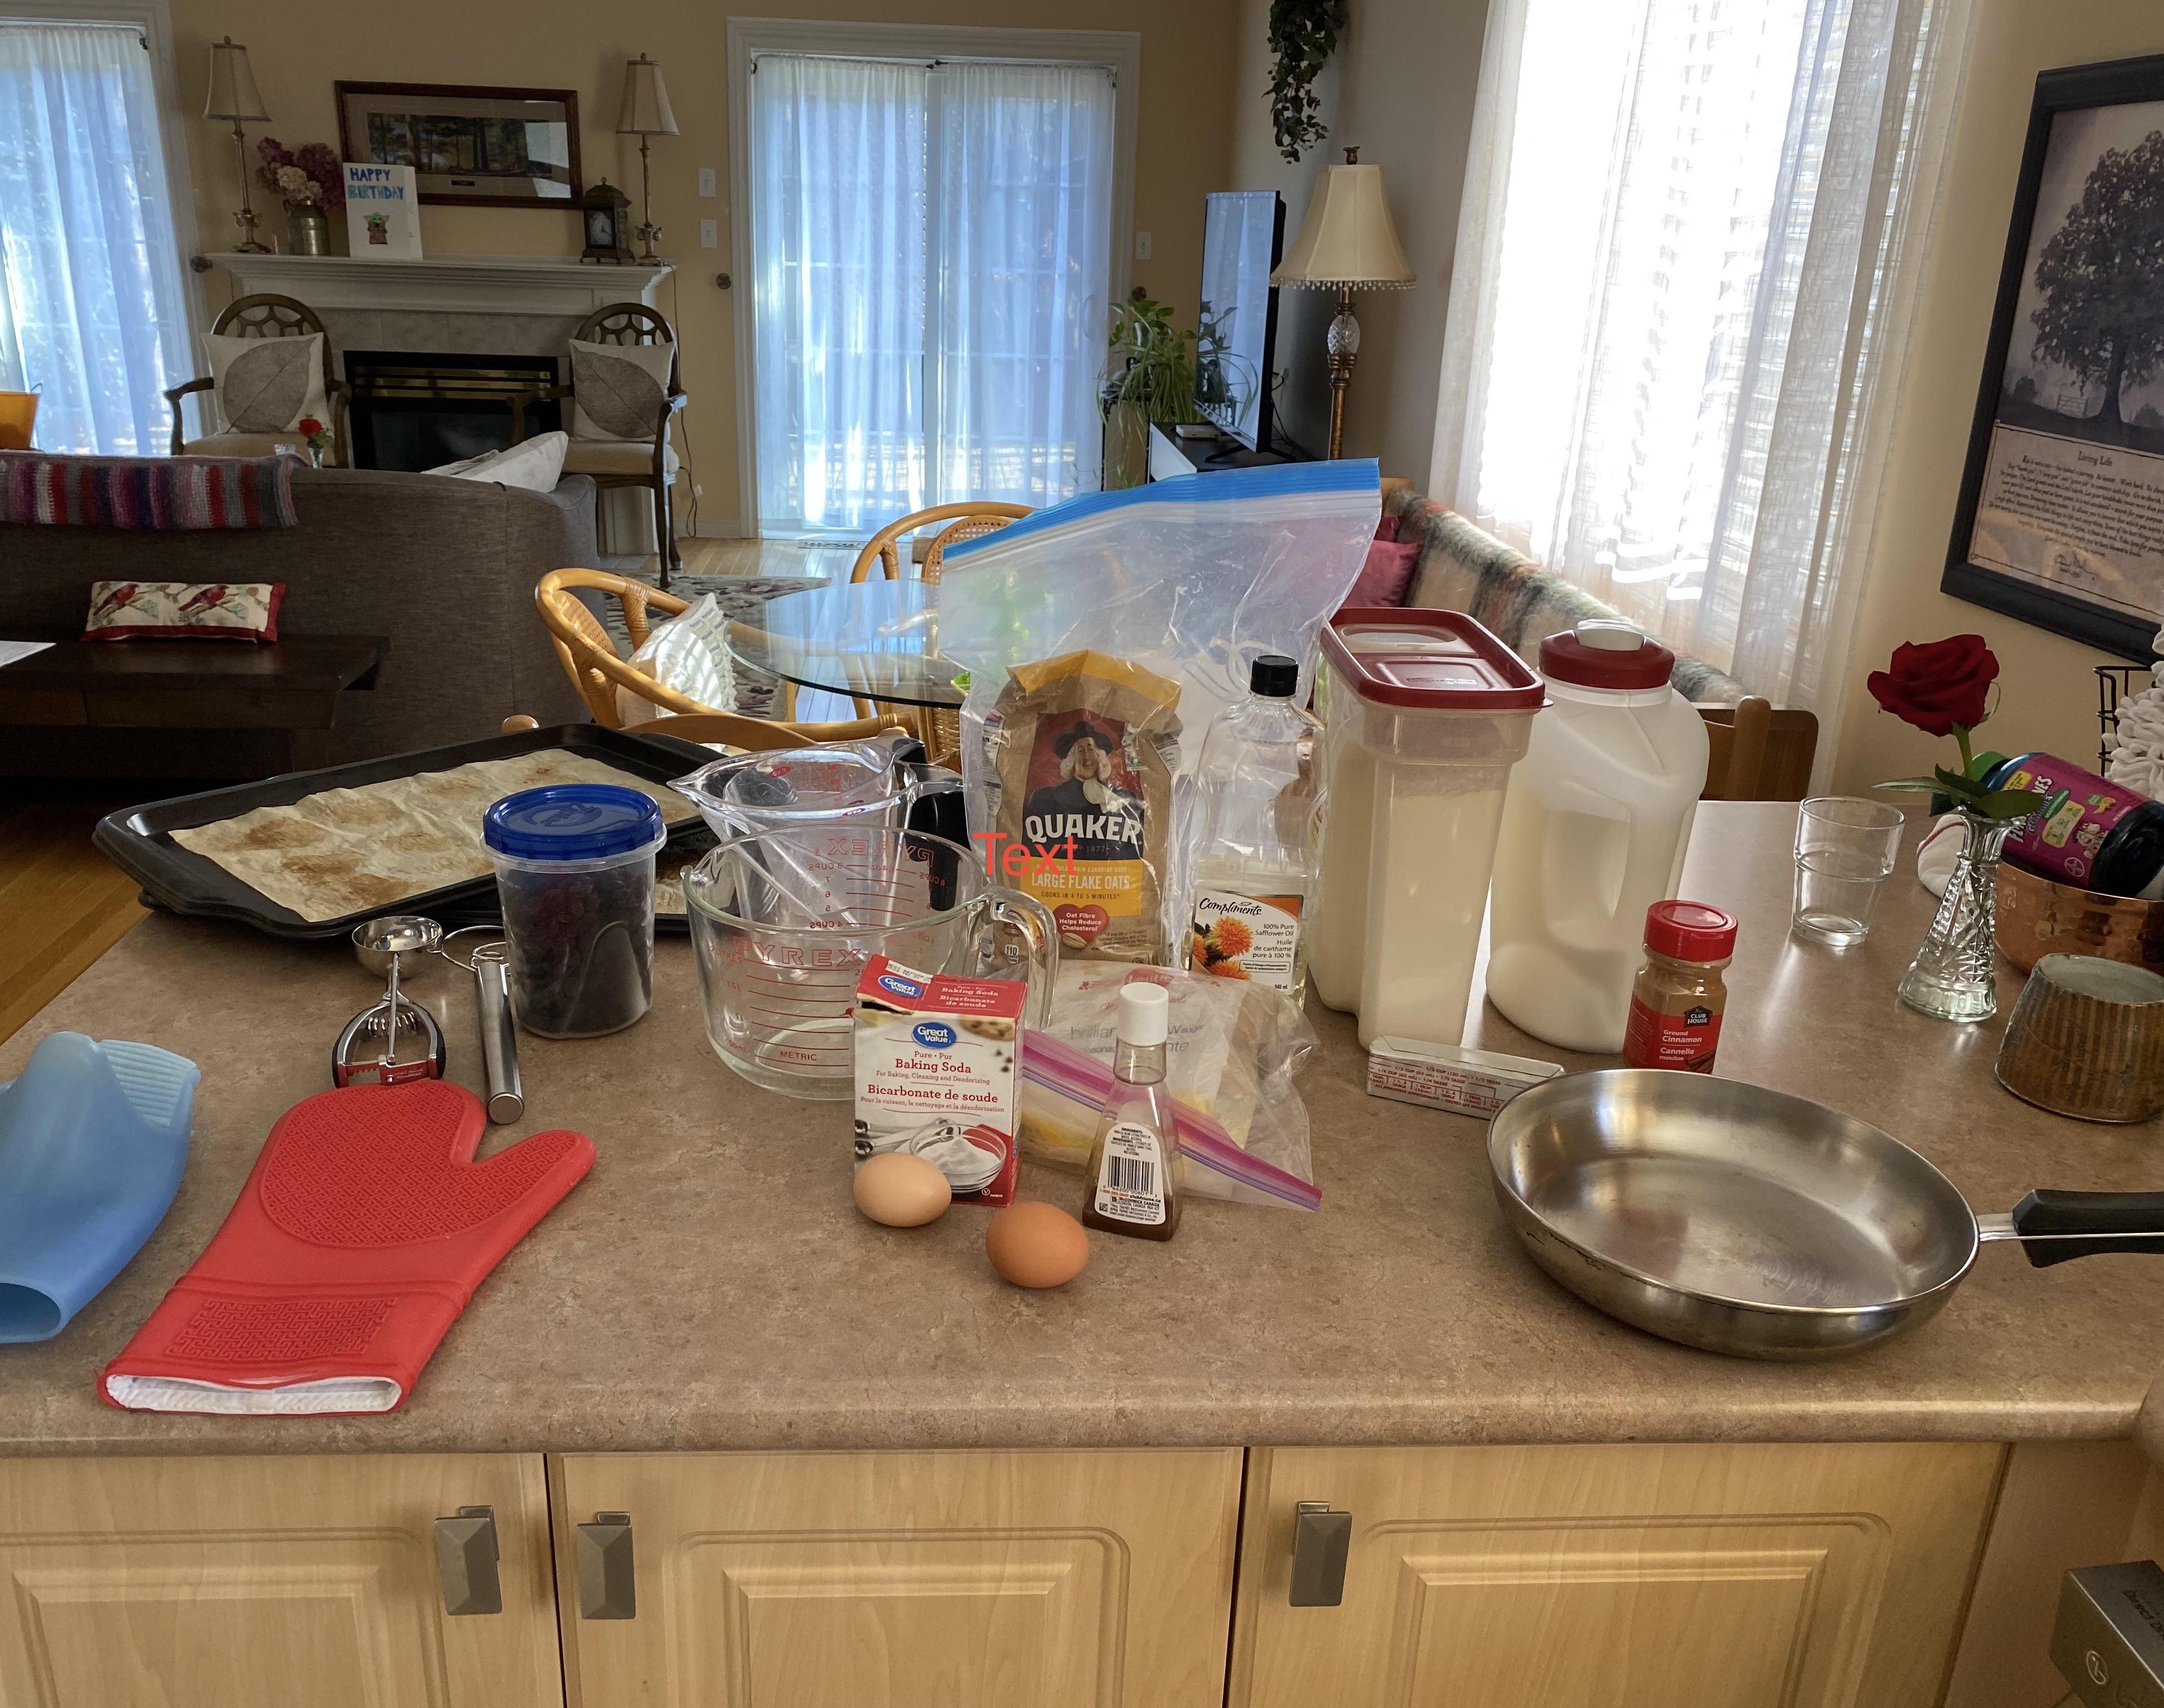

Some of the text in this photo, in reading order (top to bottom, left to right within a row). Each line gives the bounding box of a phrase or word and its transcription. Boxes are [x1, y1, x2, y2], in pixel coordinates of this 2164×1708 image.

[350, 168, 390, 181] HAPPY
[347, 185, 404, 200] BIRTHDAY
[1025, 813, 1142, 844] QUAKER
[1031, 873, 1130, 890] LARGE FLAKE OATS
[1199, 897, 1262, 916] Compliments
[733, 935, 861, 967] PYREX
[1007, 946, 1017, 956] 110
[885, 977, 916, 992] Great
[891, 984, 915, 996] Value
[942, 987, 974, 996] Baking
[939, 995, 996, 1004] Bicarbonate
[917, 1026, 948, 1038] Great
[925, 1034, 949, 1043] Value
[780, 1050, 817, 1061] METRIC
[895, 1058, 972, 1073] Baking Soda
[887, 1071, 910, 1079] Baking,
[911, 1073, 939, 1081] Cleaning
[953, 1075, 990, 1085] Deodorizing
[868, 1084, 998, 1103] Bicarbonate de soude
[960, 1104, 1005, 1113] désodorisation
